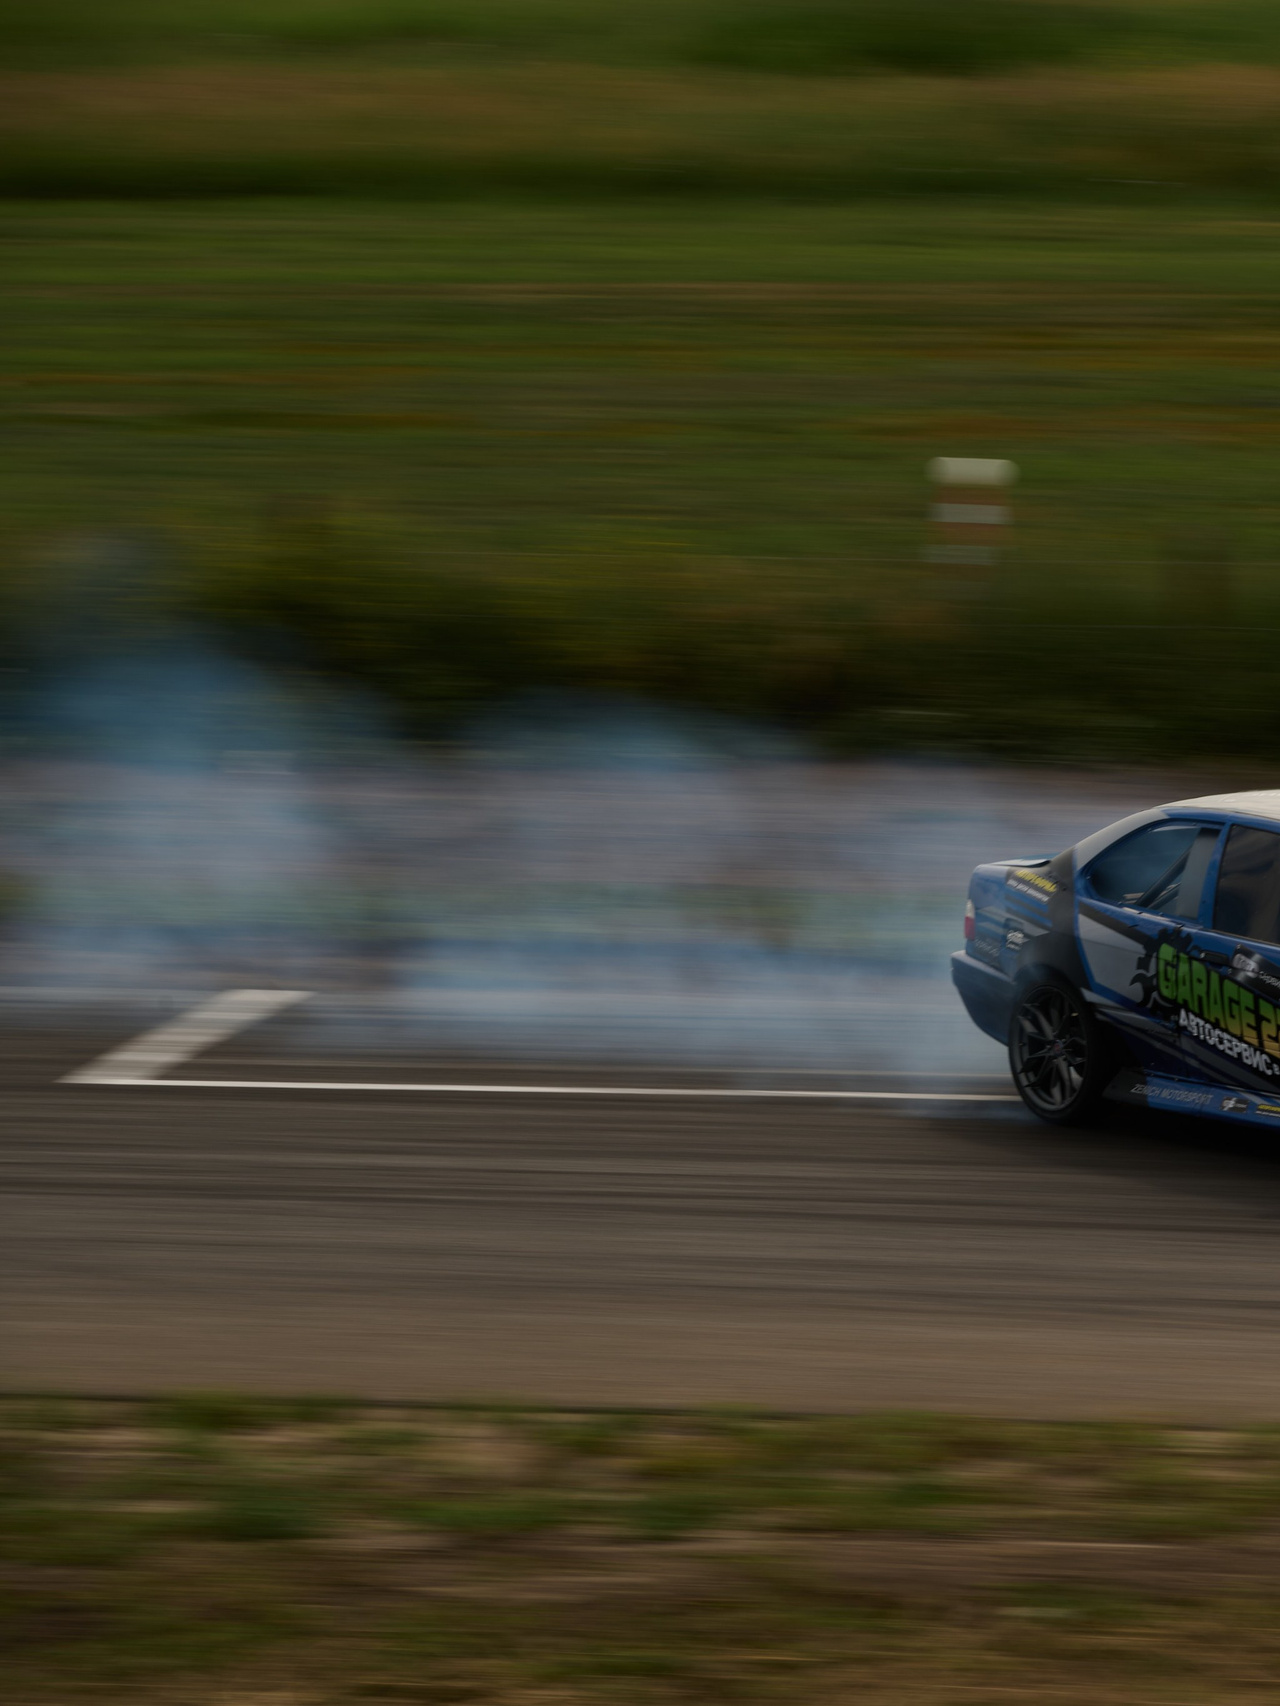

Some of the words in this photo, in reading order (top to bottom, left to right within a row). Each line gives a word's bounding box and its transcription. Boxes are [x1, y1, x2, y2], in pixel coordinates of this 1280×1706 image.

[1157, 943, 1260, 1048] GARAGE
[1179, 1008, 1273, 1076] АВТОСЕРВИС
[1129, 1083, 1160, 1097] ZENICH
[1160, 1087, 1214, 1105] MOTORSPORT
